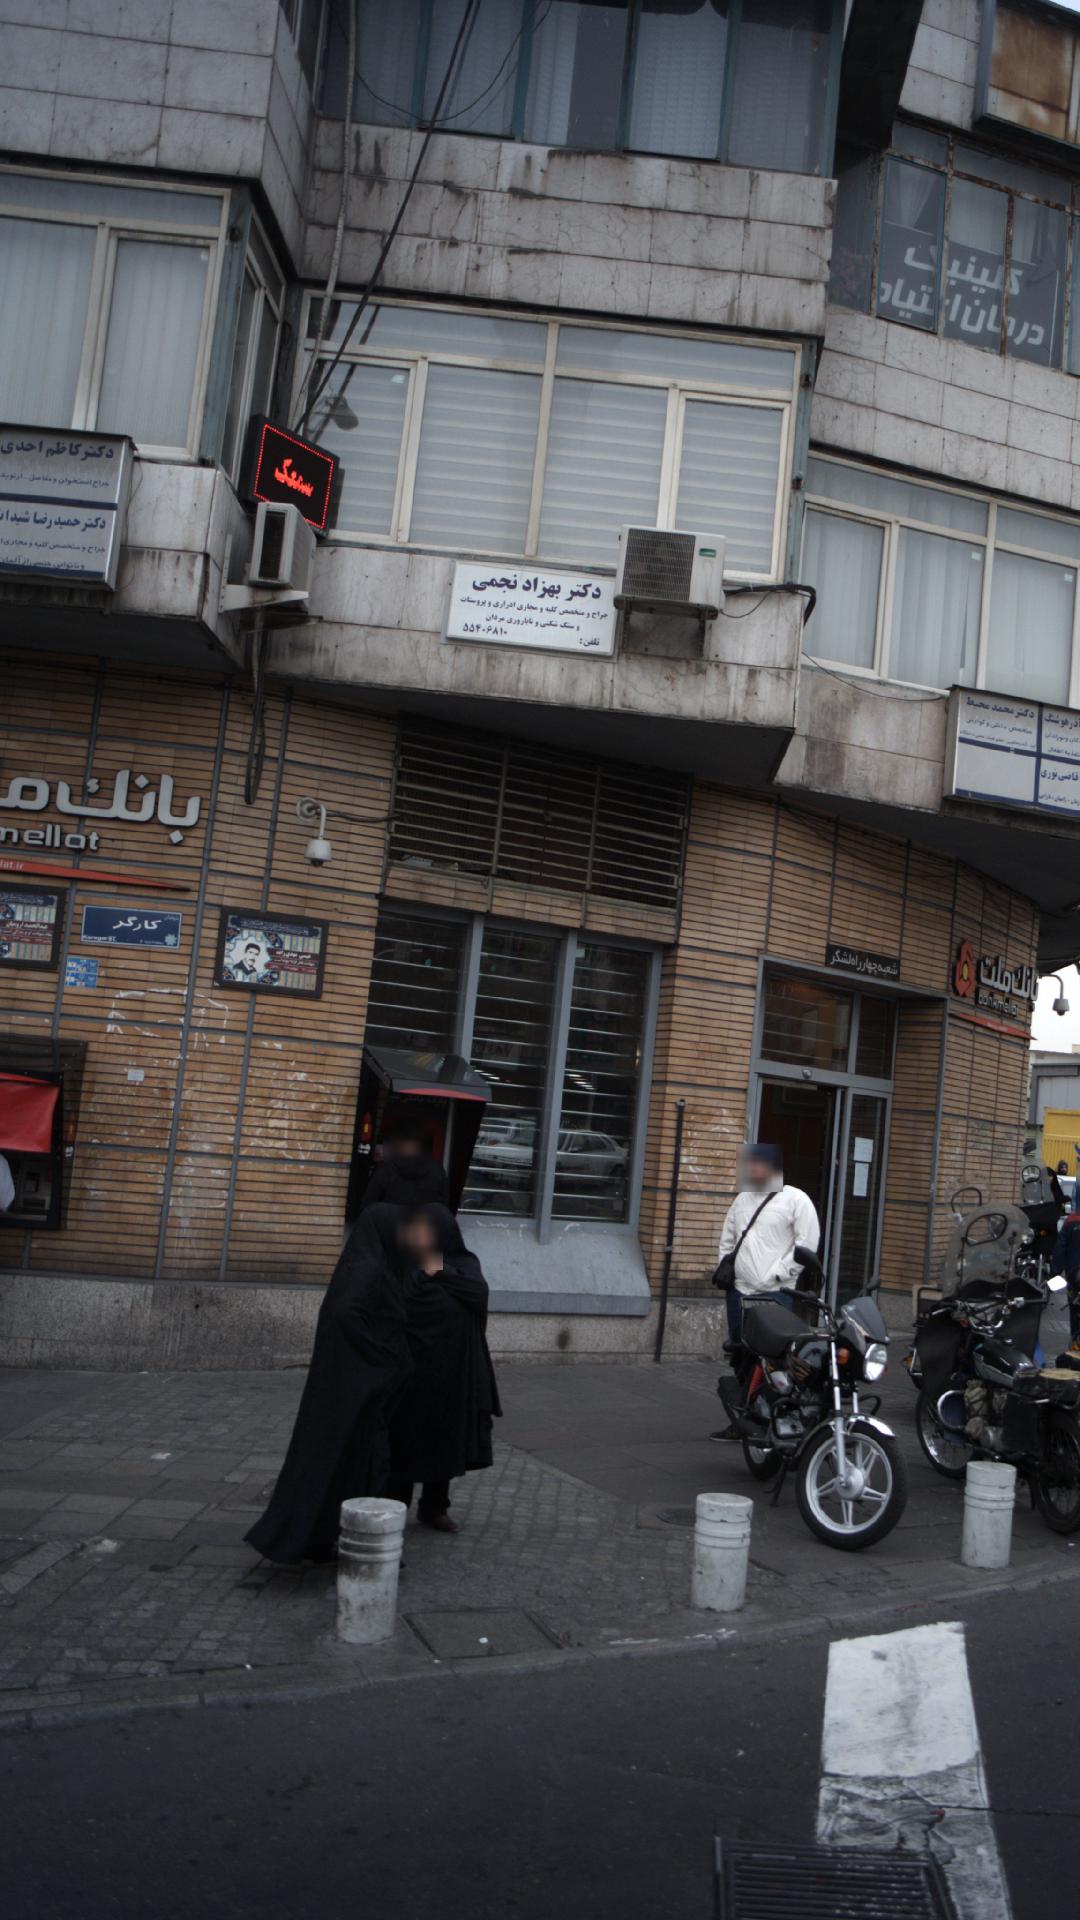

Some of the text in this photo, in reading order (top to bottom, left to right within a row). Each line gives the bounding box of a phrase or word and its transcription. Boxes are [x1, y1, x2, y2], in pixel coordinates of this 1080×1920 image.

[904, 246, 1023, 296] کلینیک
[960, 299, 1045, 346] درمان
[45, 441, 81, 458] کاظم
[80, 445, 114, 461] دکتر
[81, 516, 106, 532] دکتر
[472, 574, 602, 601] دکتر بهزاد نجمی
[492, 601, 516, 609] ادراری
[517, 603, 538, 611] مجاری
[559, 607, 585, 617] متخصص
[507, 616, 533, 625] ناباروری
[591, 609, 608, 620] جراح
[56, 769, 201, 844] بانک
[112, 916, 162, 932] کارگر
[877, 963, 898, 976] شعبه
[980, 955, 1012, 993] ملت
